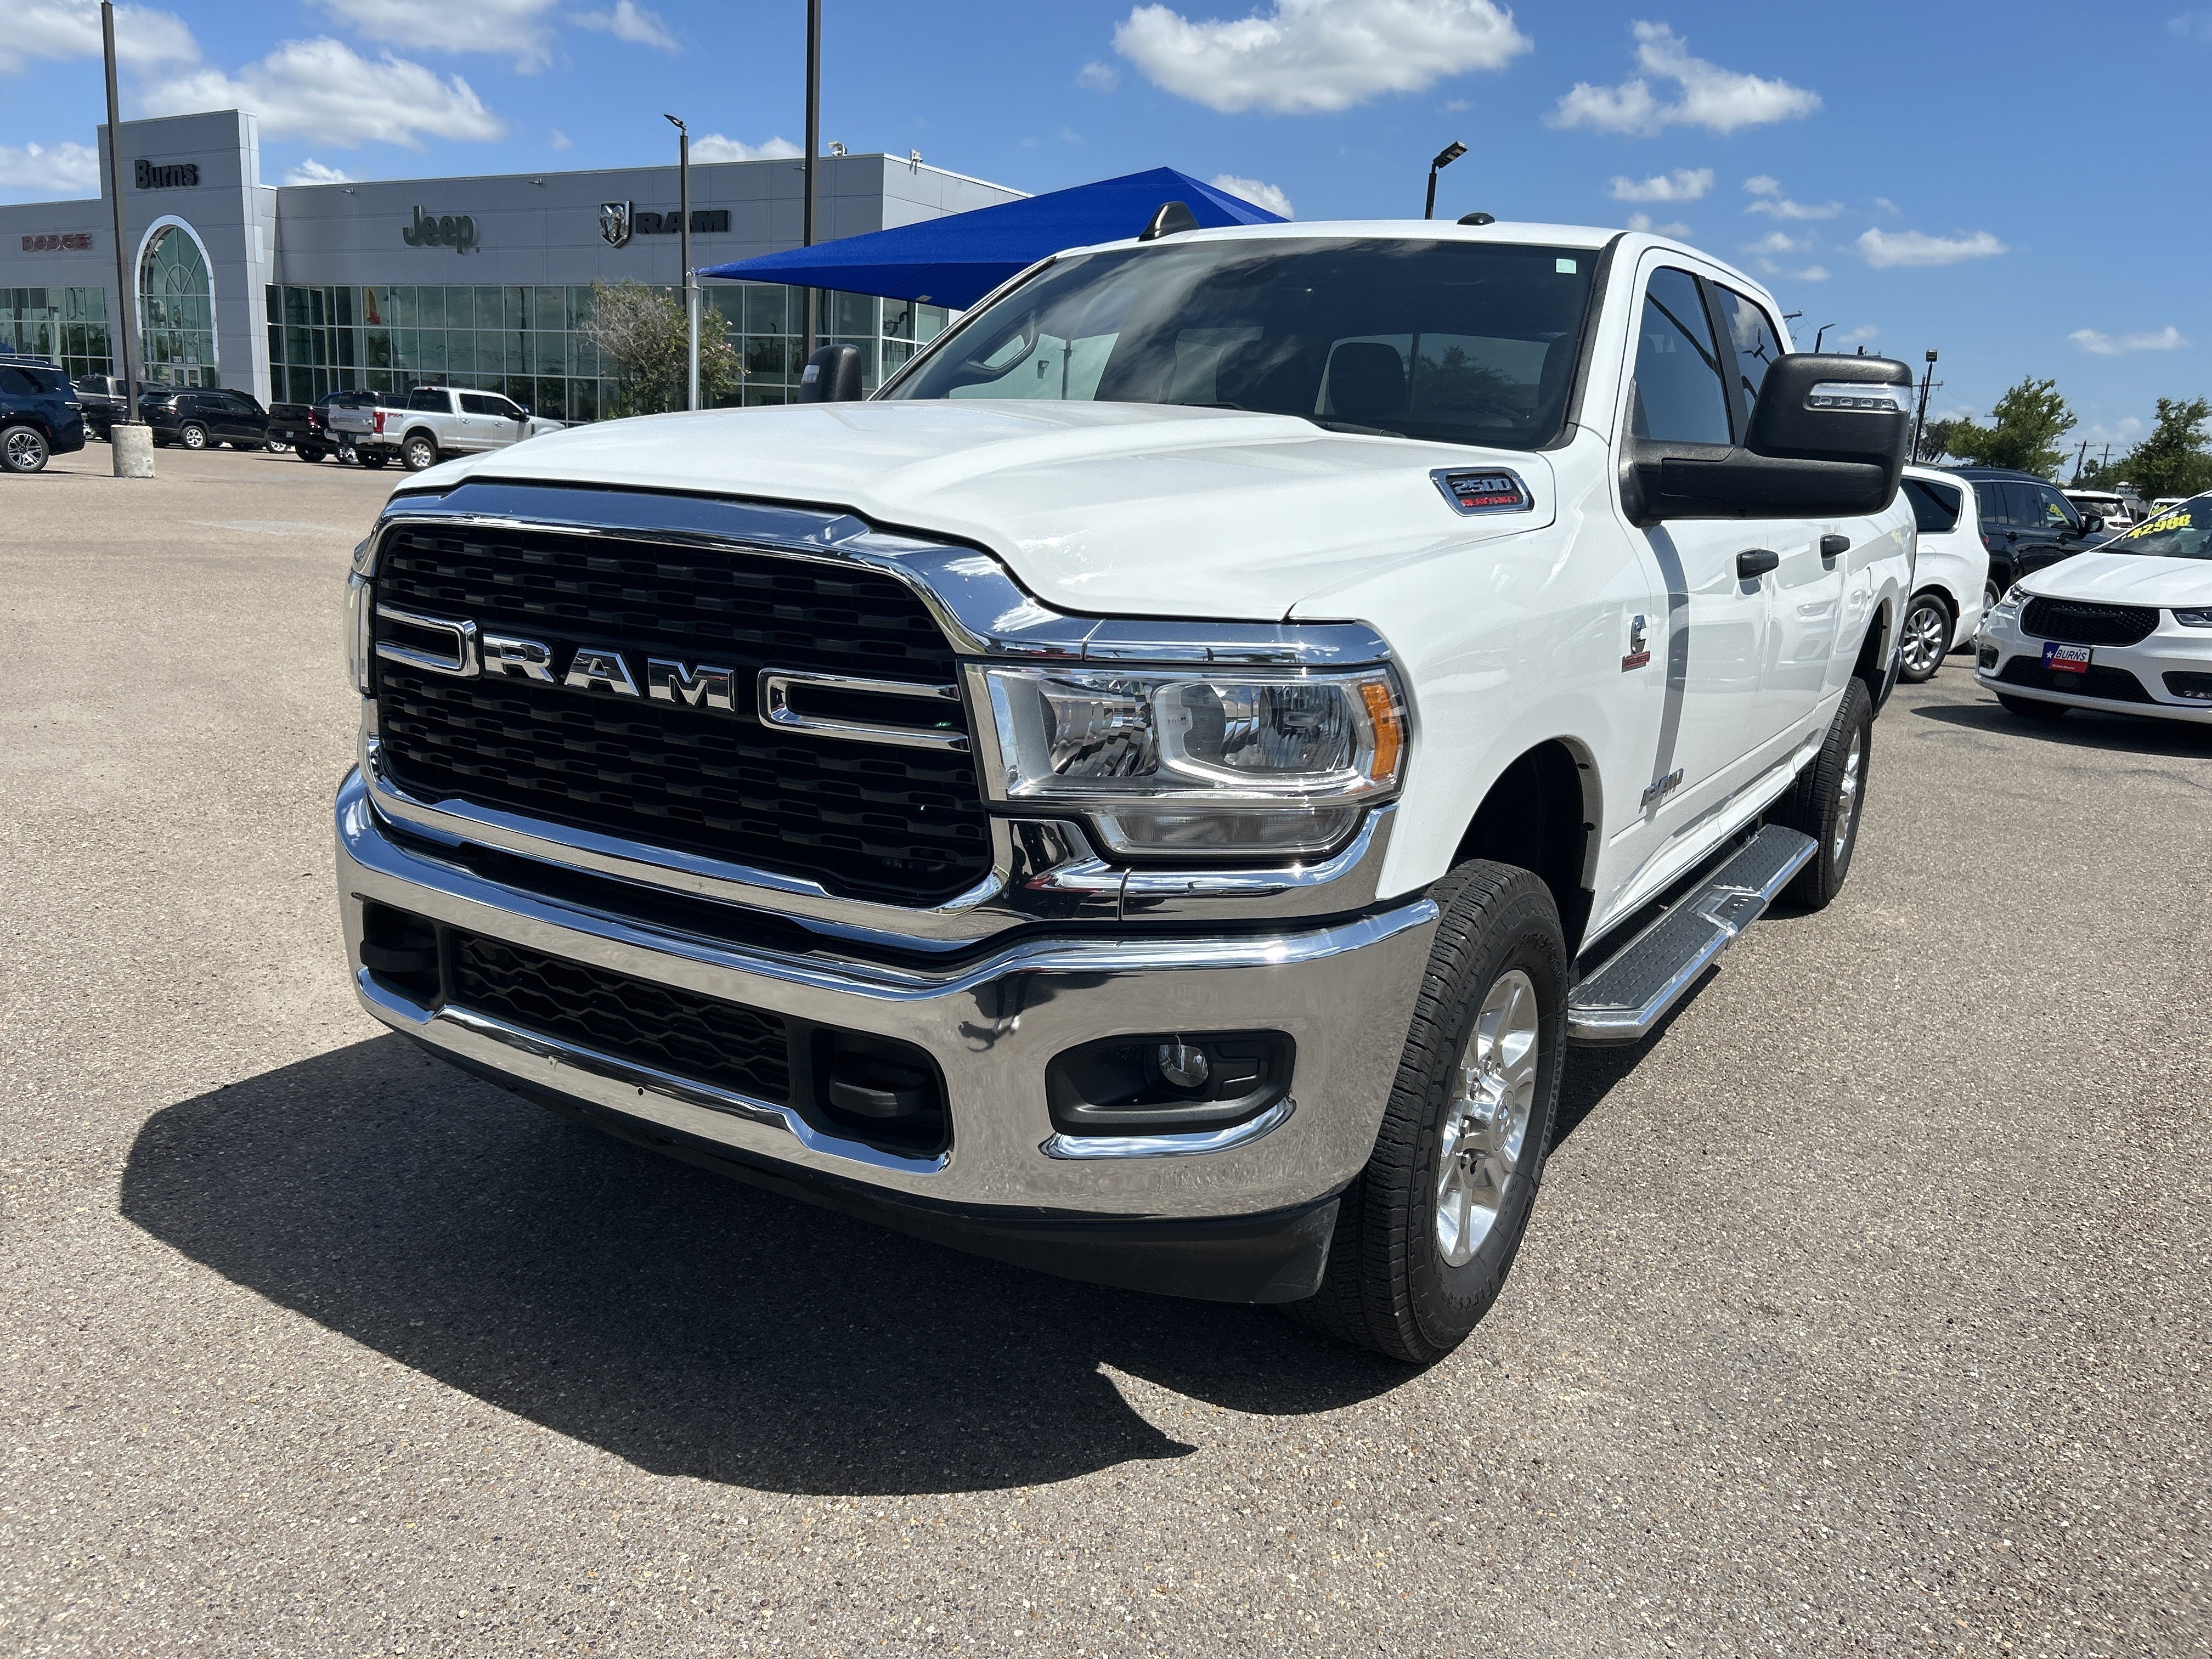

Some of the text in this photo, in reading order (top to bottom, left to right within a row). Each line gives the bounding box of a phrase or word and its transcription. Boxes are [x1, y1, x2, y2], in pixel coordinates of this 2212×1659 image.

[134, 160, 198, 189] Burns
[403, 206, 475, 254] Jeep
[635, 210, 729, 234] RAM
[22, 234, 92, 251] DODGE
[1451, 478, 1512, 495] 2500
[2127, 514, 2192, 539] 42988
[2055, 649, 2087, 661] BURNS
[483, 633, 736, 712] RAM
[1640, 768, 1684, 806] RAM
[1543, 1040, 1563, 1144] TRANSFORCE
